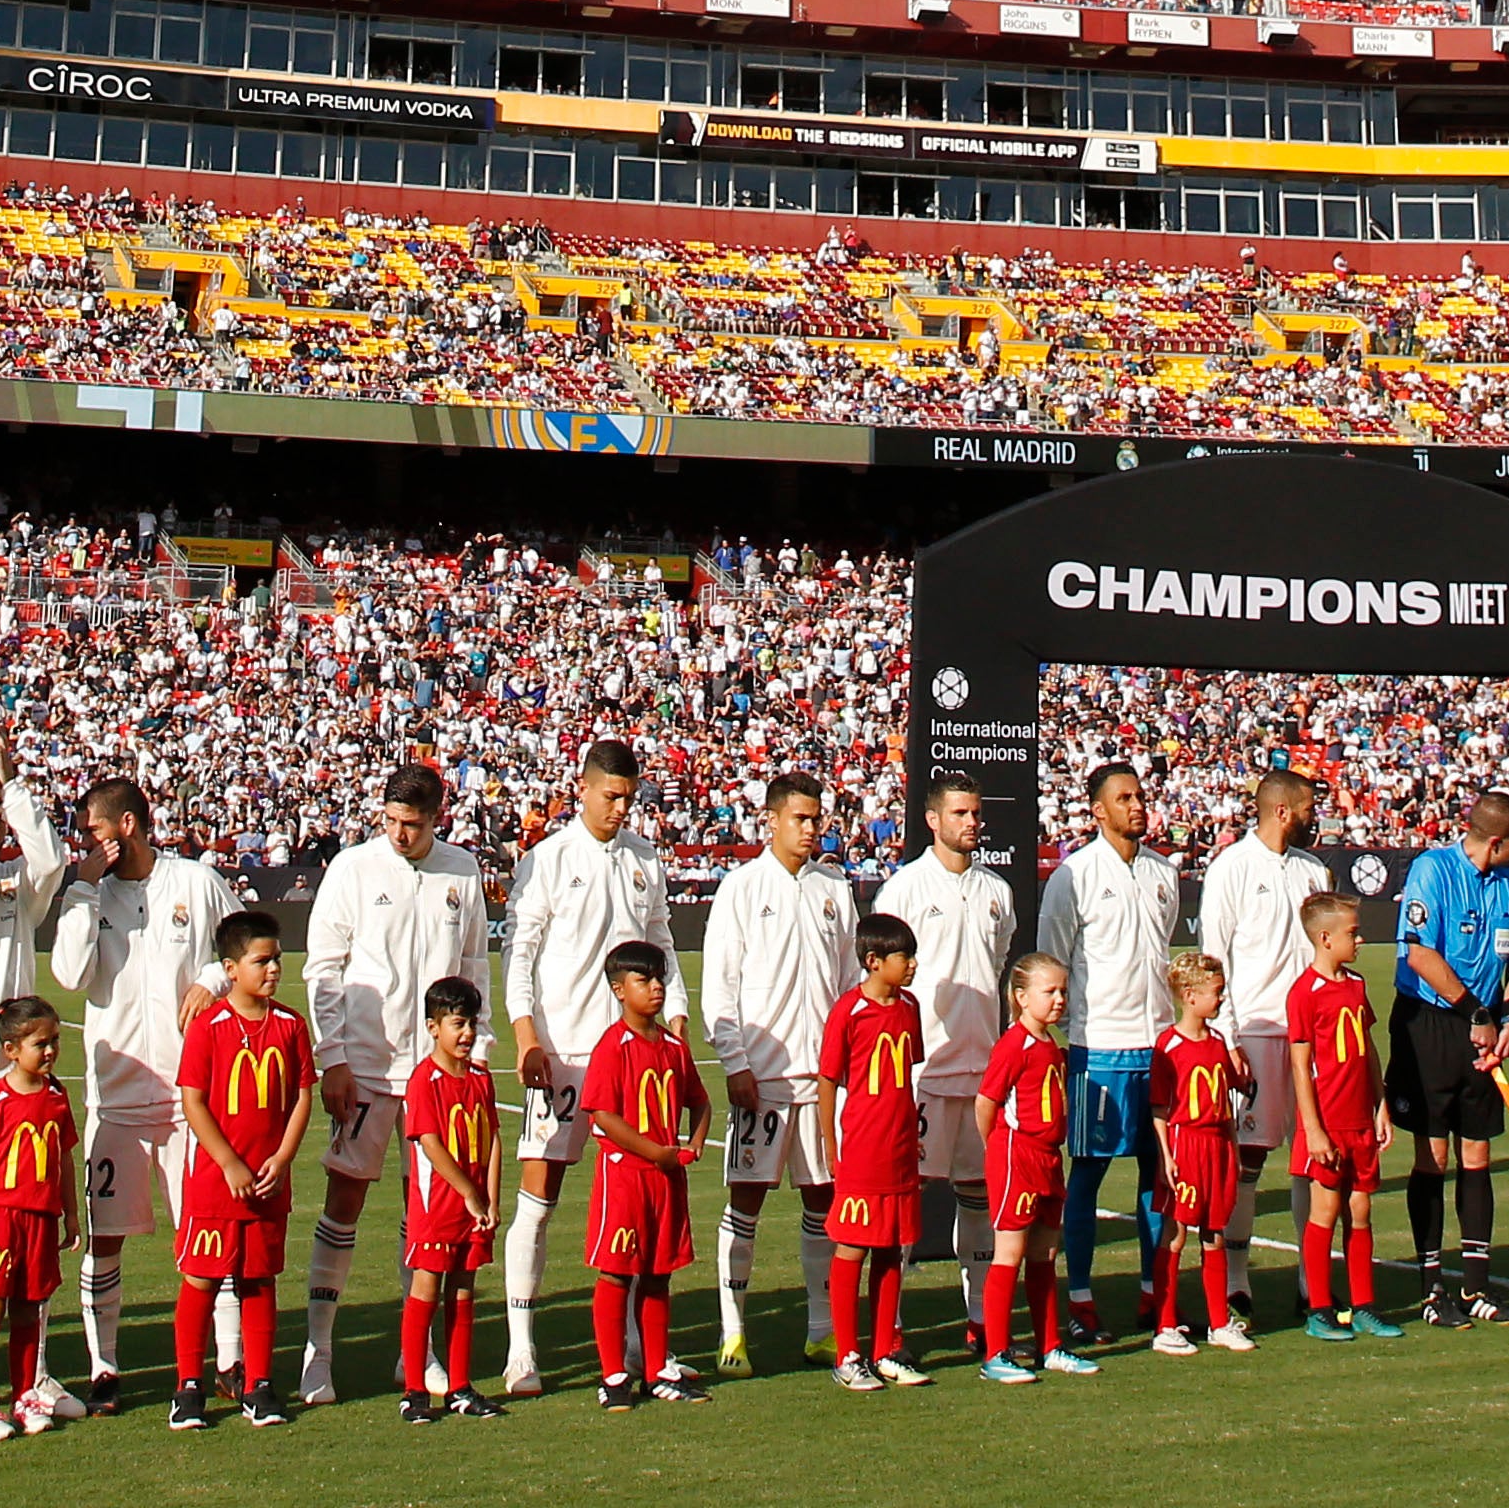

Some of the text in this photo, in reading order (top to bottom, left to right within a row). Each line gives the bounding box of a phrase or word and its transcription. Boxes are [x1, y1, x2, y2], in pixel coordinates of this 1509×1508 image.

[1003, 9, 1029, 19] John
[1134, 16, 1160, 28] Mark
[1003, 20, 1048, 32] RIGGINS
[1356, 30, 1396, 42] Charles
[1356, 42, 1389, 53] MANN
[238, 87, 474, 120] ULTRA PREMIUM VODKA
[707, 123, 1077, 158] DOWNLOAD THE REDSKINS OFFICIAL MOBILE APP
[934, 437, 1075, 465] REAL MADRID
[1047, 561, 1442, 626] CHAMPIONS
[1449, 582, 1508, 626] MEET
[931, 718, 1036, 739] International
[931, 742, 1028, 764] Champions
[740, 1107, 779, 1146] 29
